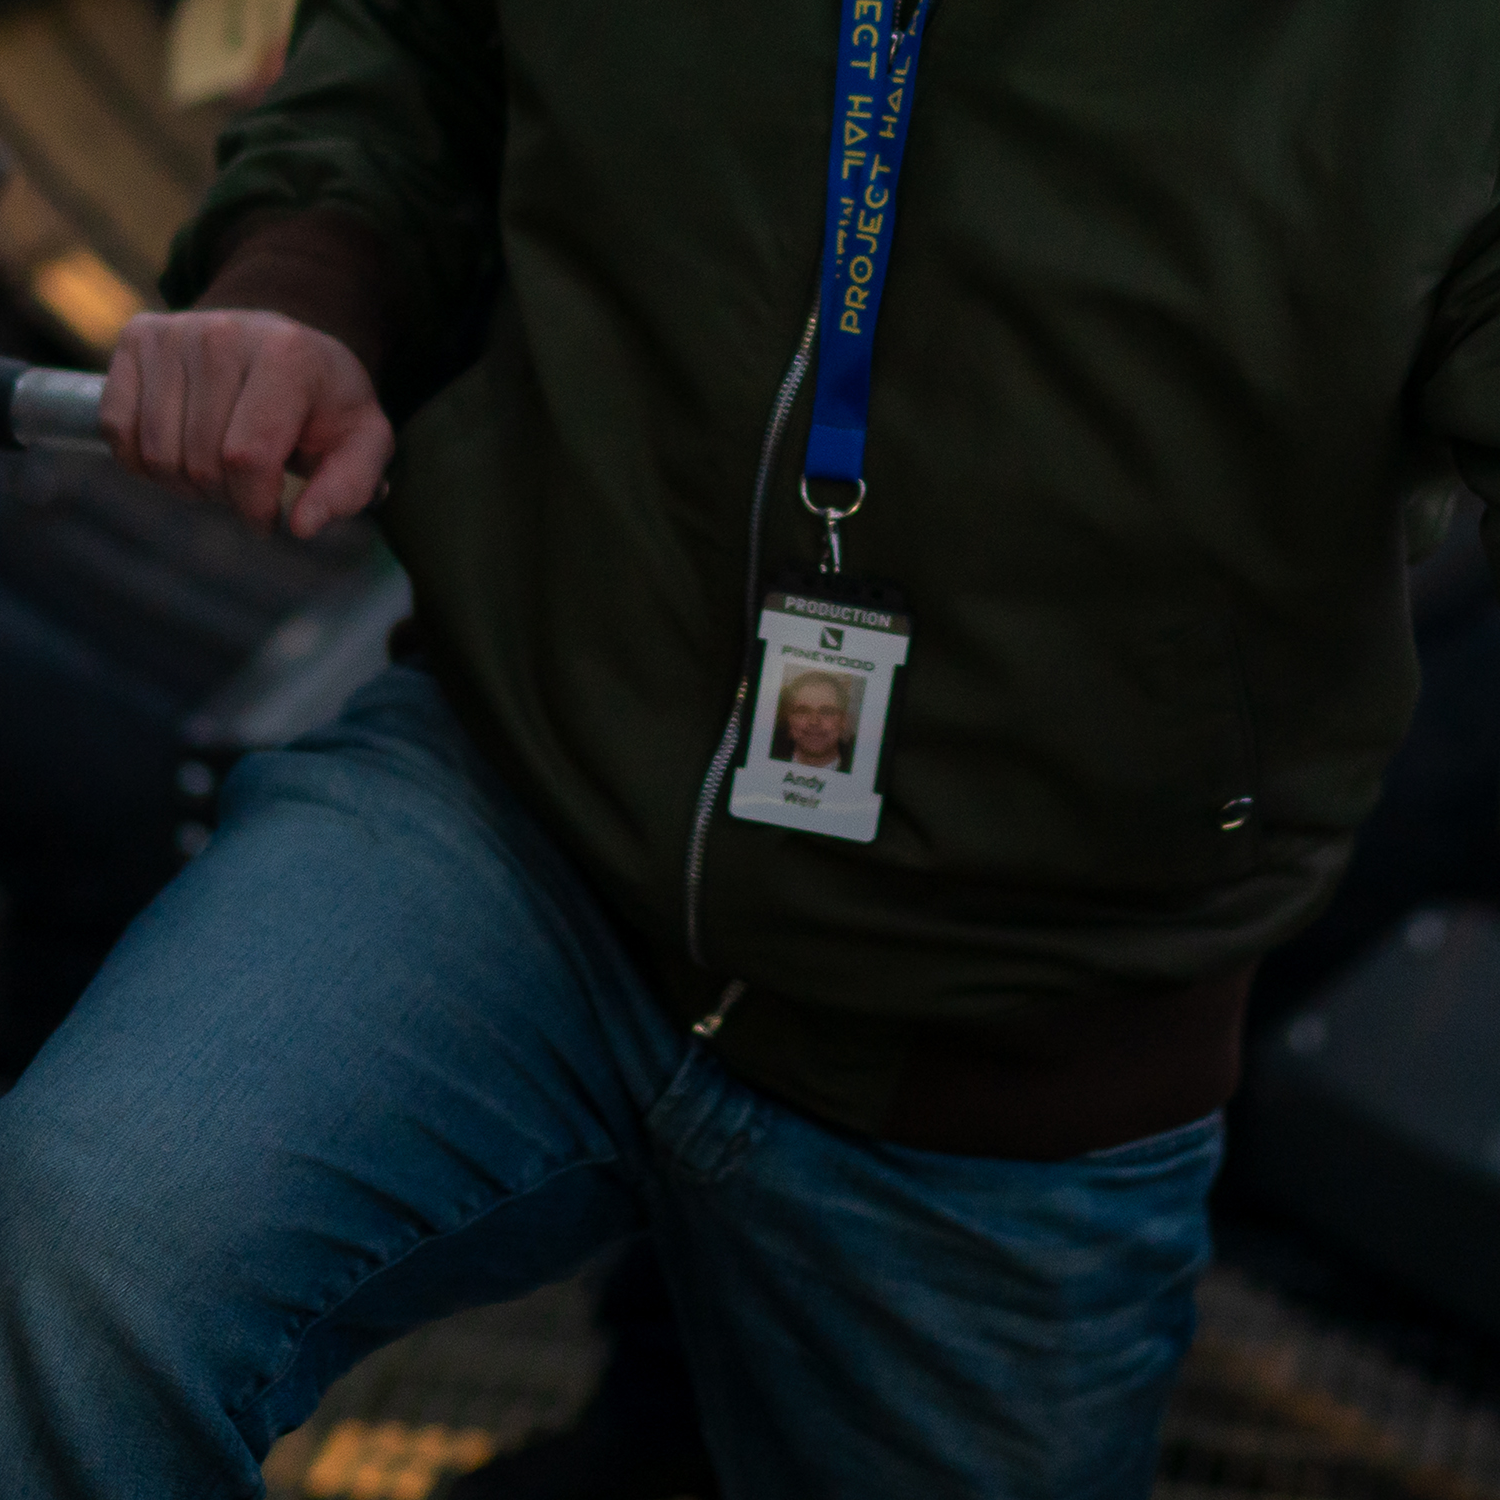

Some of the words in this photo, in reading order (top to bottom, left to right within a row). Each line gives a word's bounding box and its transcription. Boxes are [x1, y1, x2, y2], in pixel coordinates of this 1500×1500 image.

[842, 94, 873, 180] HAIL
[840, 154, 892, 334] PROJECT
[879, 54, 913, 138] HAIL
[785, 597, 892, 628] PRODUCTION
[782, 646, 875, 671] PINEWOOD
[783, 771, 826, 792] Andy
